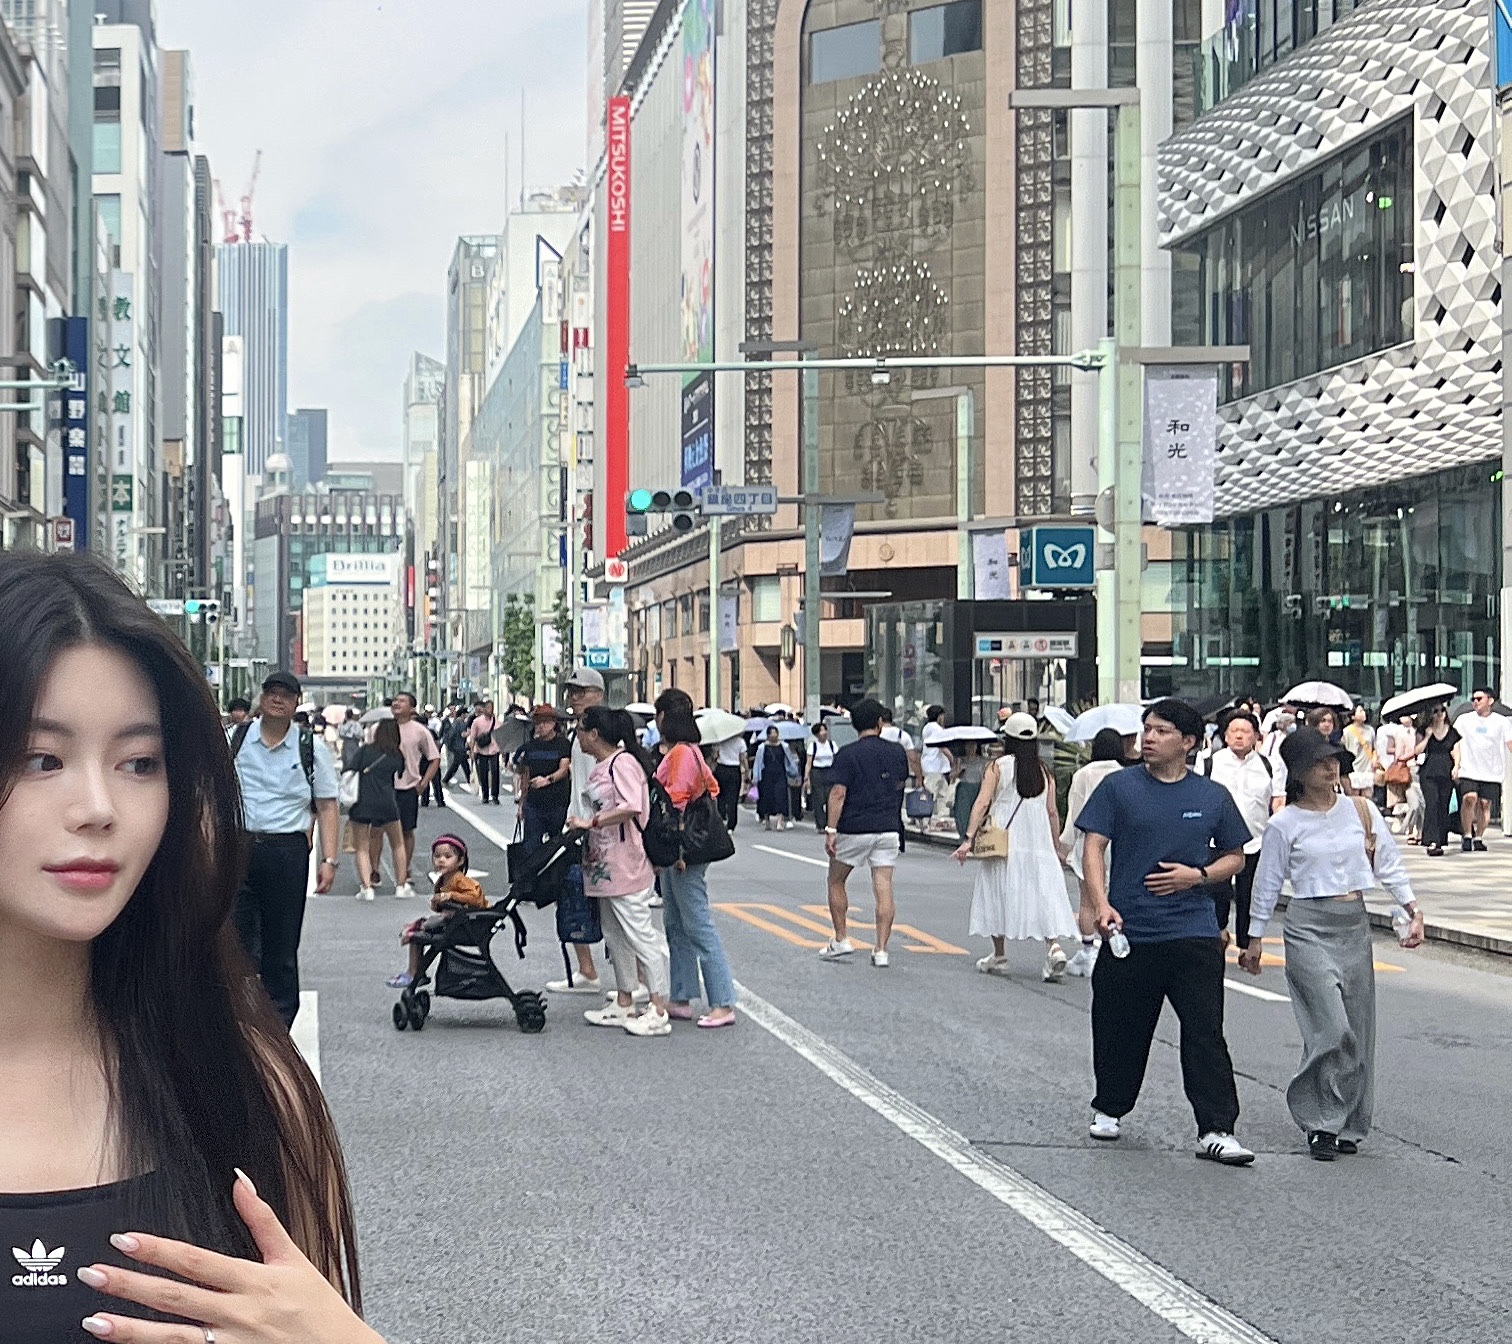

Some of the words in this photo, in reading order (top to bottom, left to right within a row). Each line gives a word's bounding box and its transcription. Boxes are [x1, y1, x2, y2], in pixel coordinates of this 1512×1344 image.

[610, 104, 628, 233] MITSUKOSHI
[1290, 193, 1354, 248] NISSAN
[113, 295, 132, 414] 教文館
[1166, 419, 1190, 459] 和光
[11, 1272, 68, 1287] adidas
